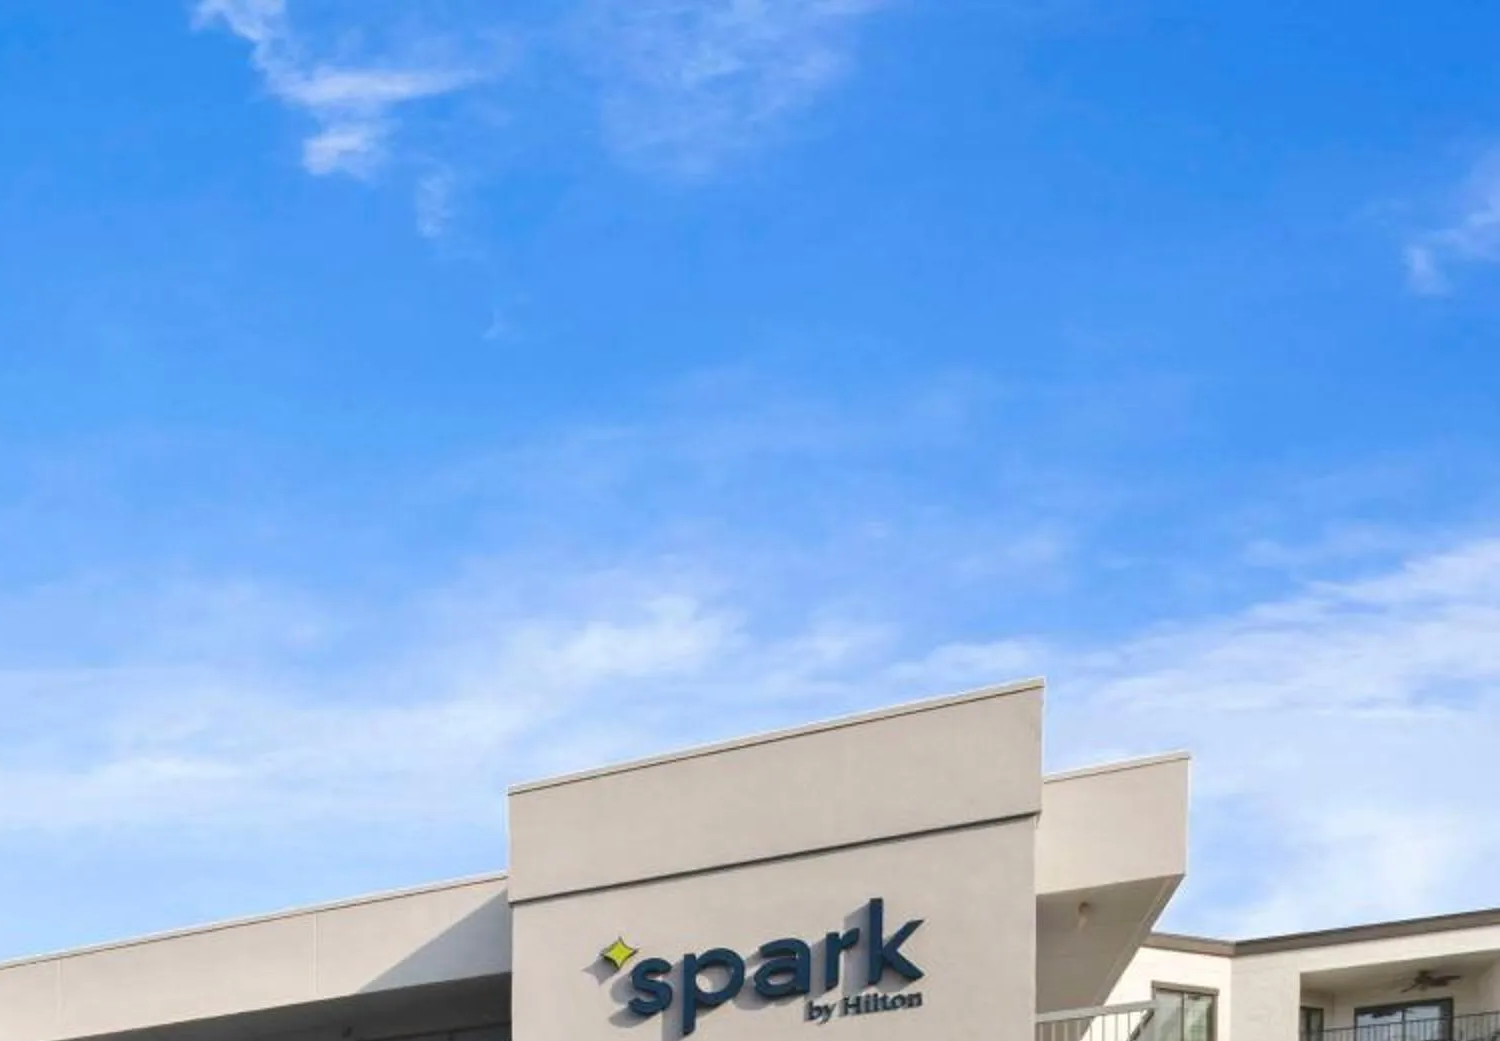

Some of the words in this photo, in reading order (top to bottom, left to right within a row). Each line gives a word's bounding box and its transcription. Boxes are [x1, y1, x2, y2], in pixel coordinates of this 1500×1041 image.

[628, 897, 925, 1036] spark
[807, 1000, 837, 1025] by
[843, 992, 923, 1016] Hilton
